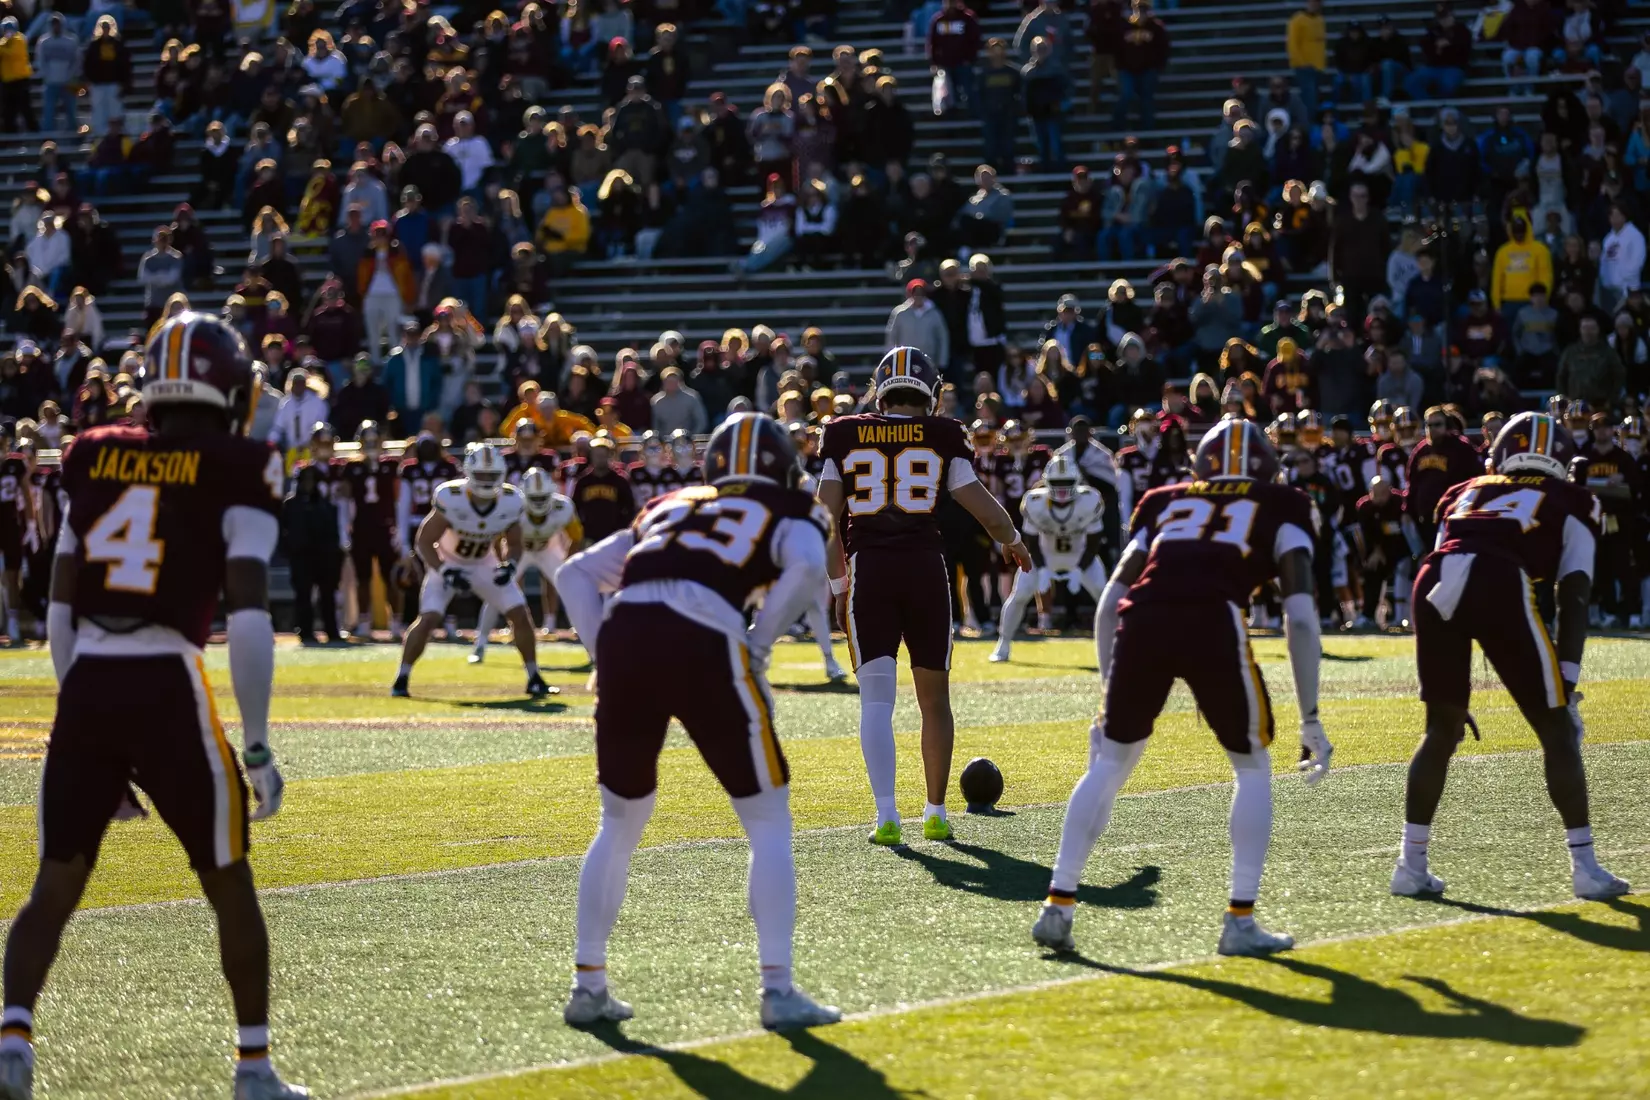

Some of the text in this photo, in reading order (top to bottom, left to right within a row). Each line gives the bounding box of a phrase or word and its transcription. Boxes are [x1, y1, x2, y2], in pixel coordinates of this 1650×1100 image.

[151, 383, 193, 396] TRUTH
[857, 424, 924, 444] VANHUIS
[89, 446, 201, 486] JACKSON
[841, 446, 944, 517] 38
[84, 483, 166, 596] 4
[626, 495, 773, 569] 23
[1154, 496, 1262, 559] 21
